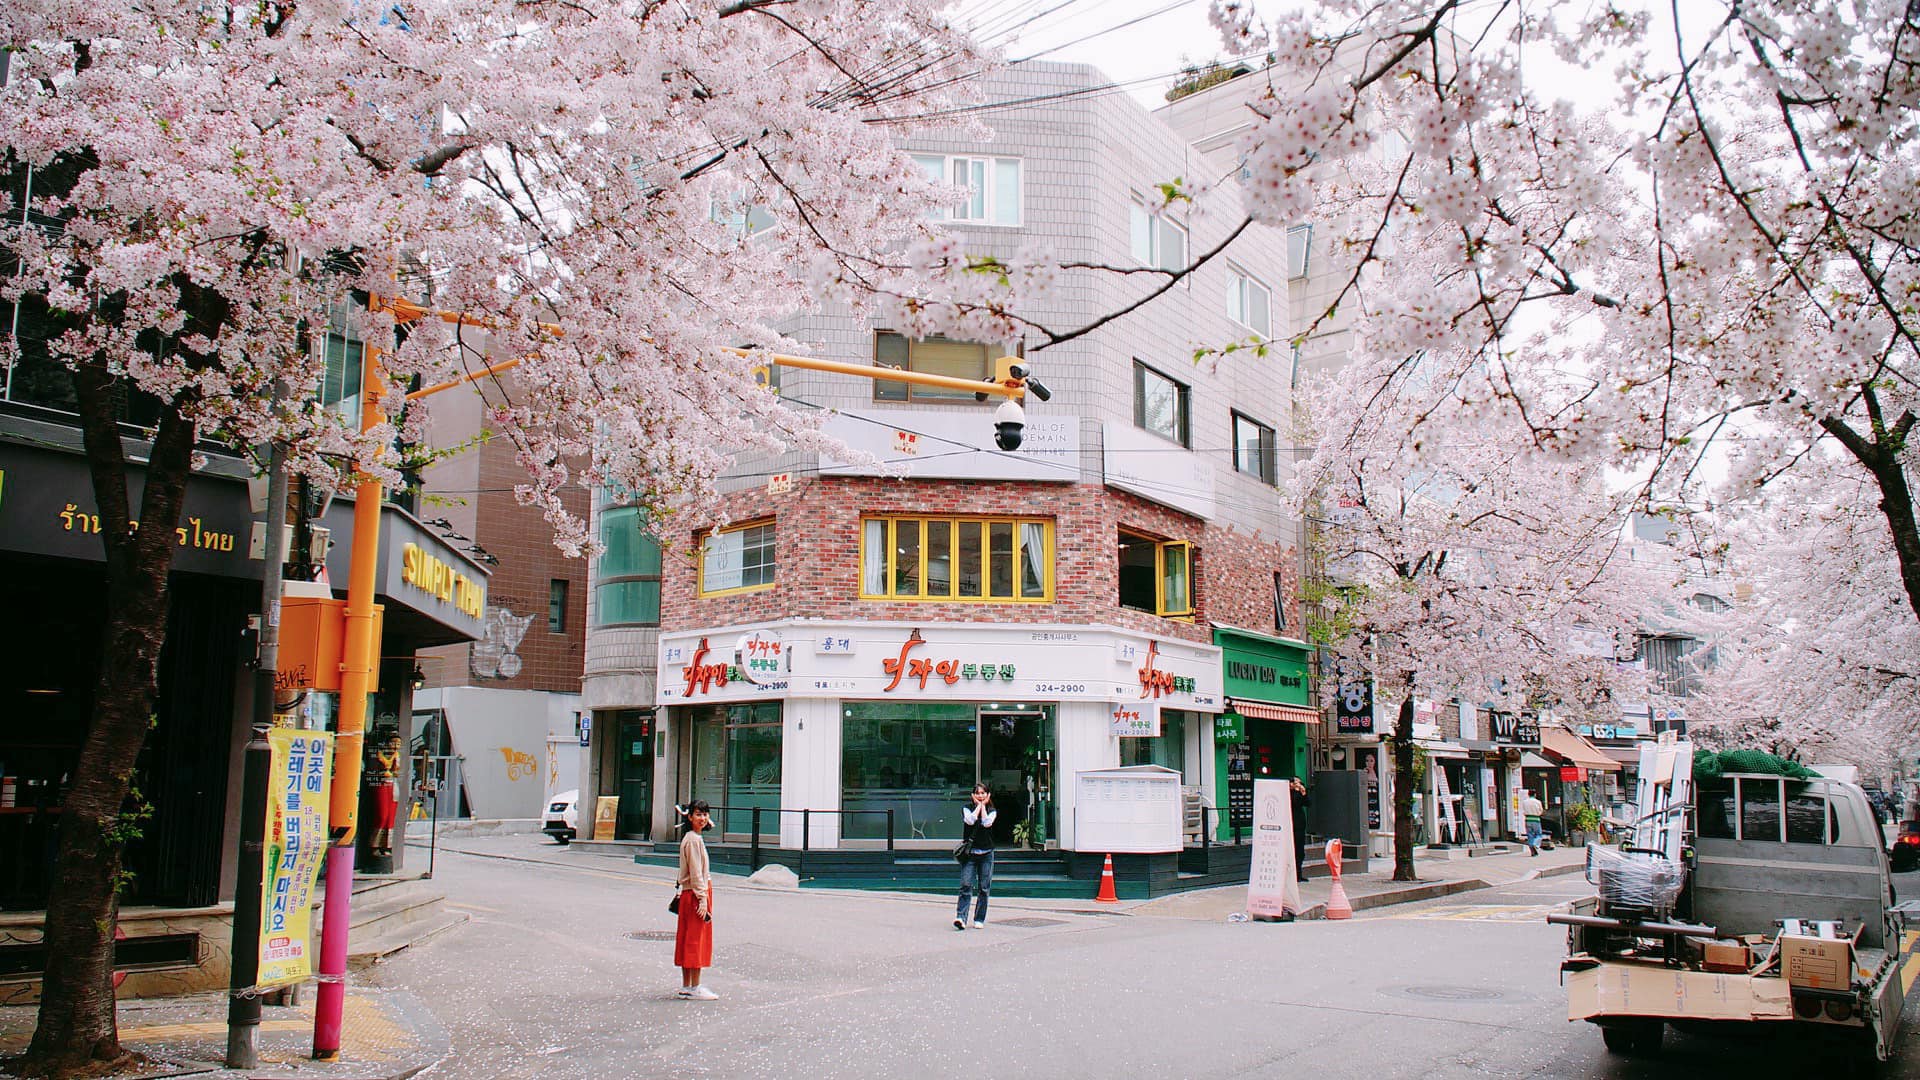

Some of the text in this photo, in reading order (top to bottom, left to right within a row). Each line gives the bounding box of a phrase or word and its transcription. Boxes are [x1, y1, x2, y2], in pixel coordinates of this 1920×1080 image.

[1022, 433, 1066, 442] DEMAIN
[1051, 423, 1065, 432] OF
[402, 542, 456, 603] SIMPLY
[747, 633, 782, 658] 디자인
[821, 636, 849, 651] 홍대
[682, 638, 728, 698] 디자인
[750, 658, 779, 671] 부동산
[883, 628, 1016, 692] 디자인 부동산
[1138, 638, 1197, 699] 디자인 부동산
[1228, 660, 1258, 682] LUCKY
[1260, 665, 1278, 685] DAY
[1034, 684, 1086, 693] 324-2900
[1112, 704, 1140, 724] 디자인
[1493, 713, 1518, 737] VIP
[286, 737, 307, 811] 쓰레기를
[306, 739, 326, 794] 이곳에
[281, 816, 301, 870] 버리지
[271, 876, 291, 932] 마시오
